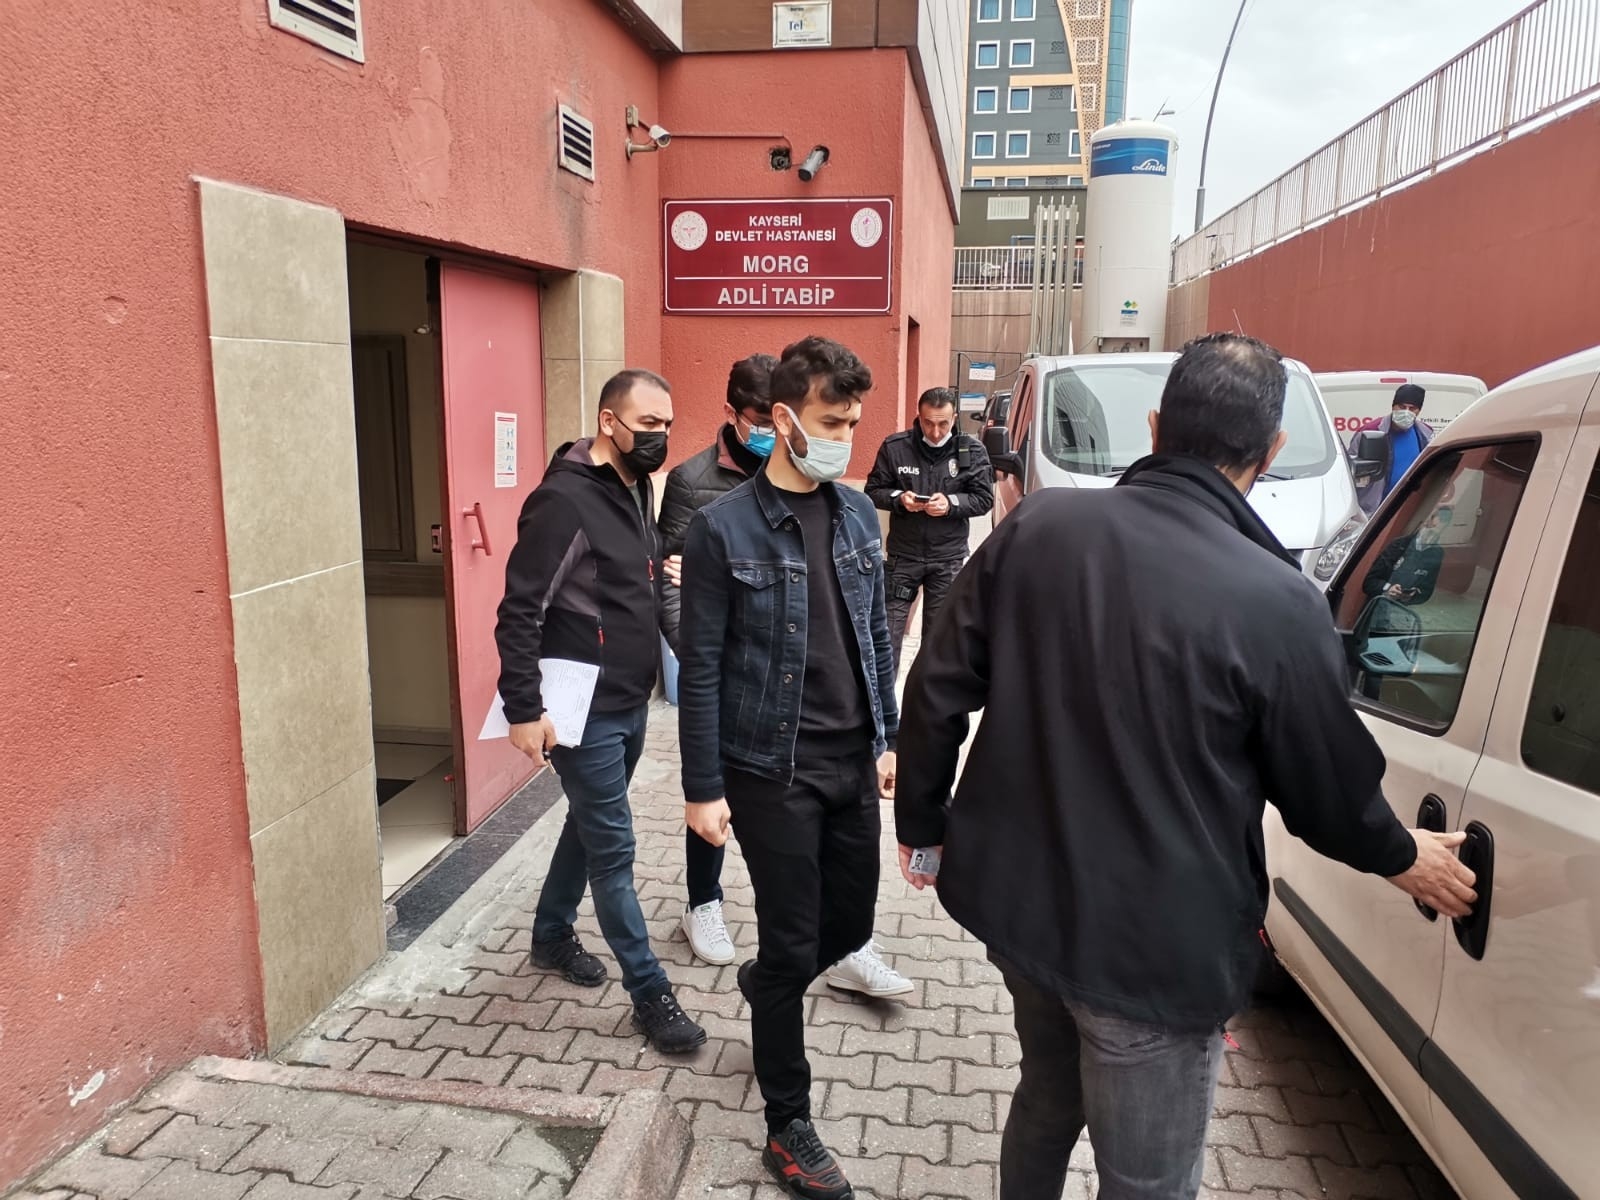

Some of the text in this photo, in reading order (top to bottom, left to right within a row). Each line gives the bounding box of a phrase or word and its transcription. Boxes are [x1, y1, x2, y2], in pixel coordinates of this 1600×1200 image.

[1132, 158, 1167, 172] Linde
[749, 213, 802, 227] KAYSERİ
[715, 227, 836, 242] DEVLET HASTANESİ
[743, 255, 809, 273] MORG
[717, 283, 835, 305] ADLİ TABİP
